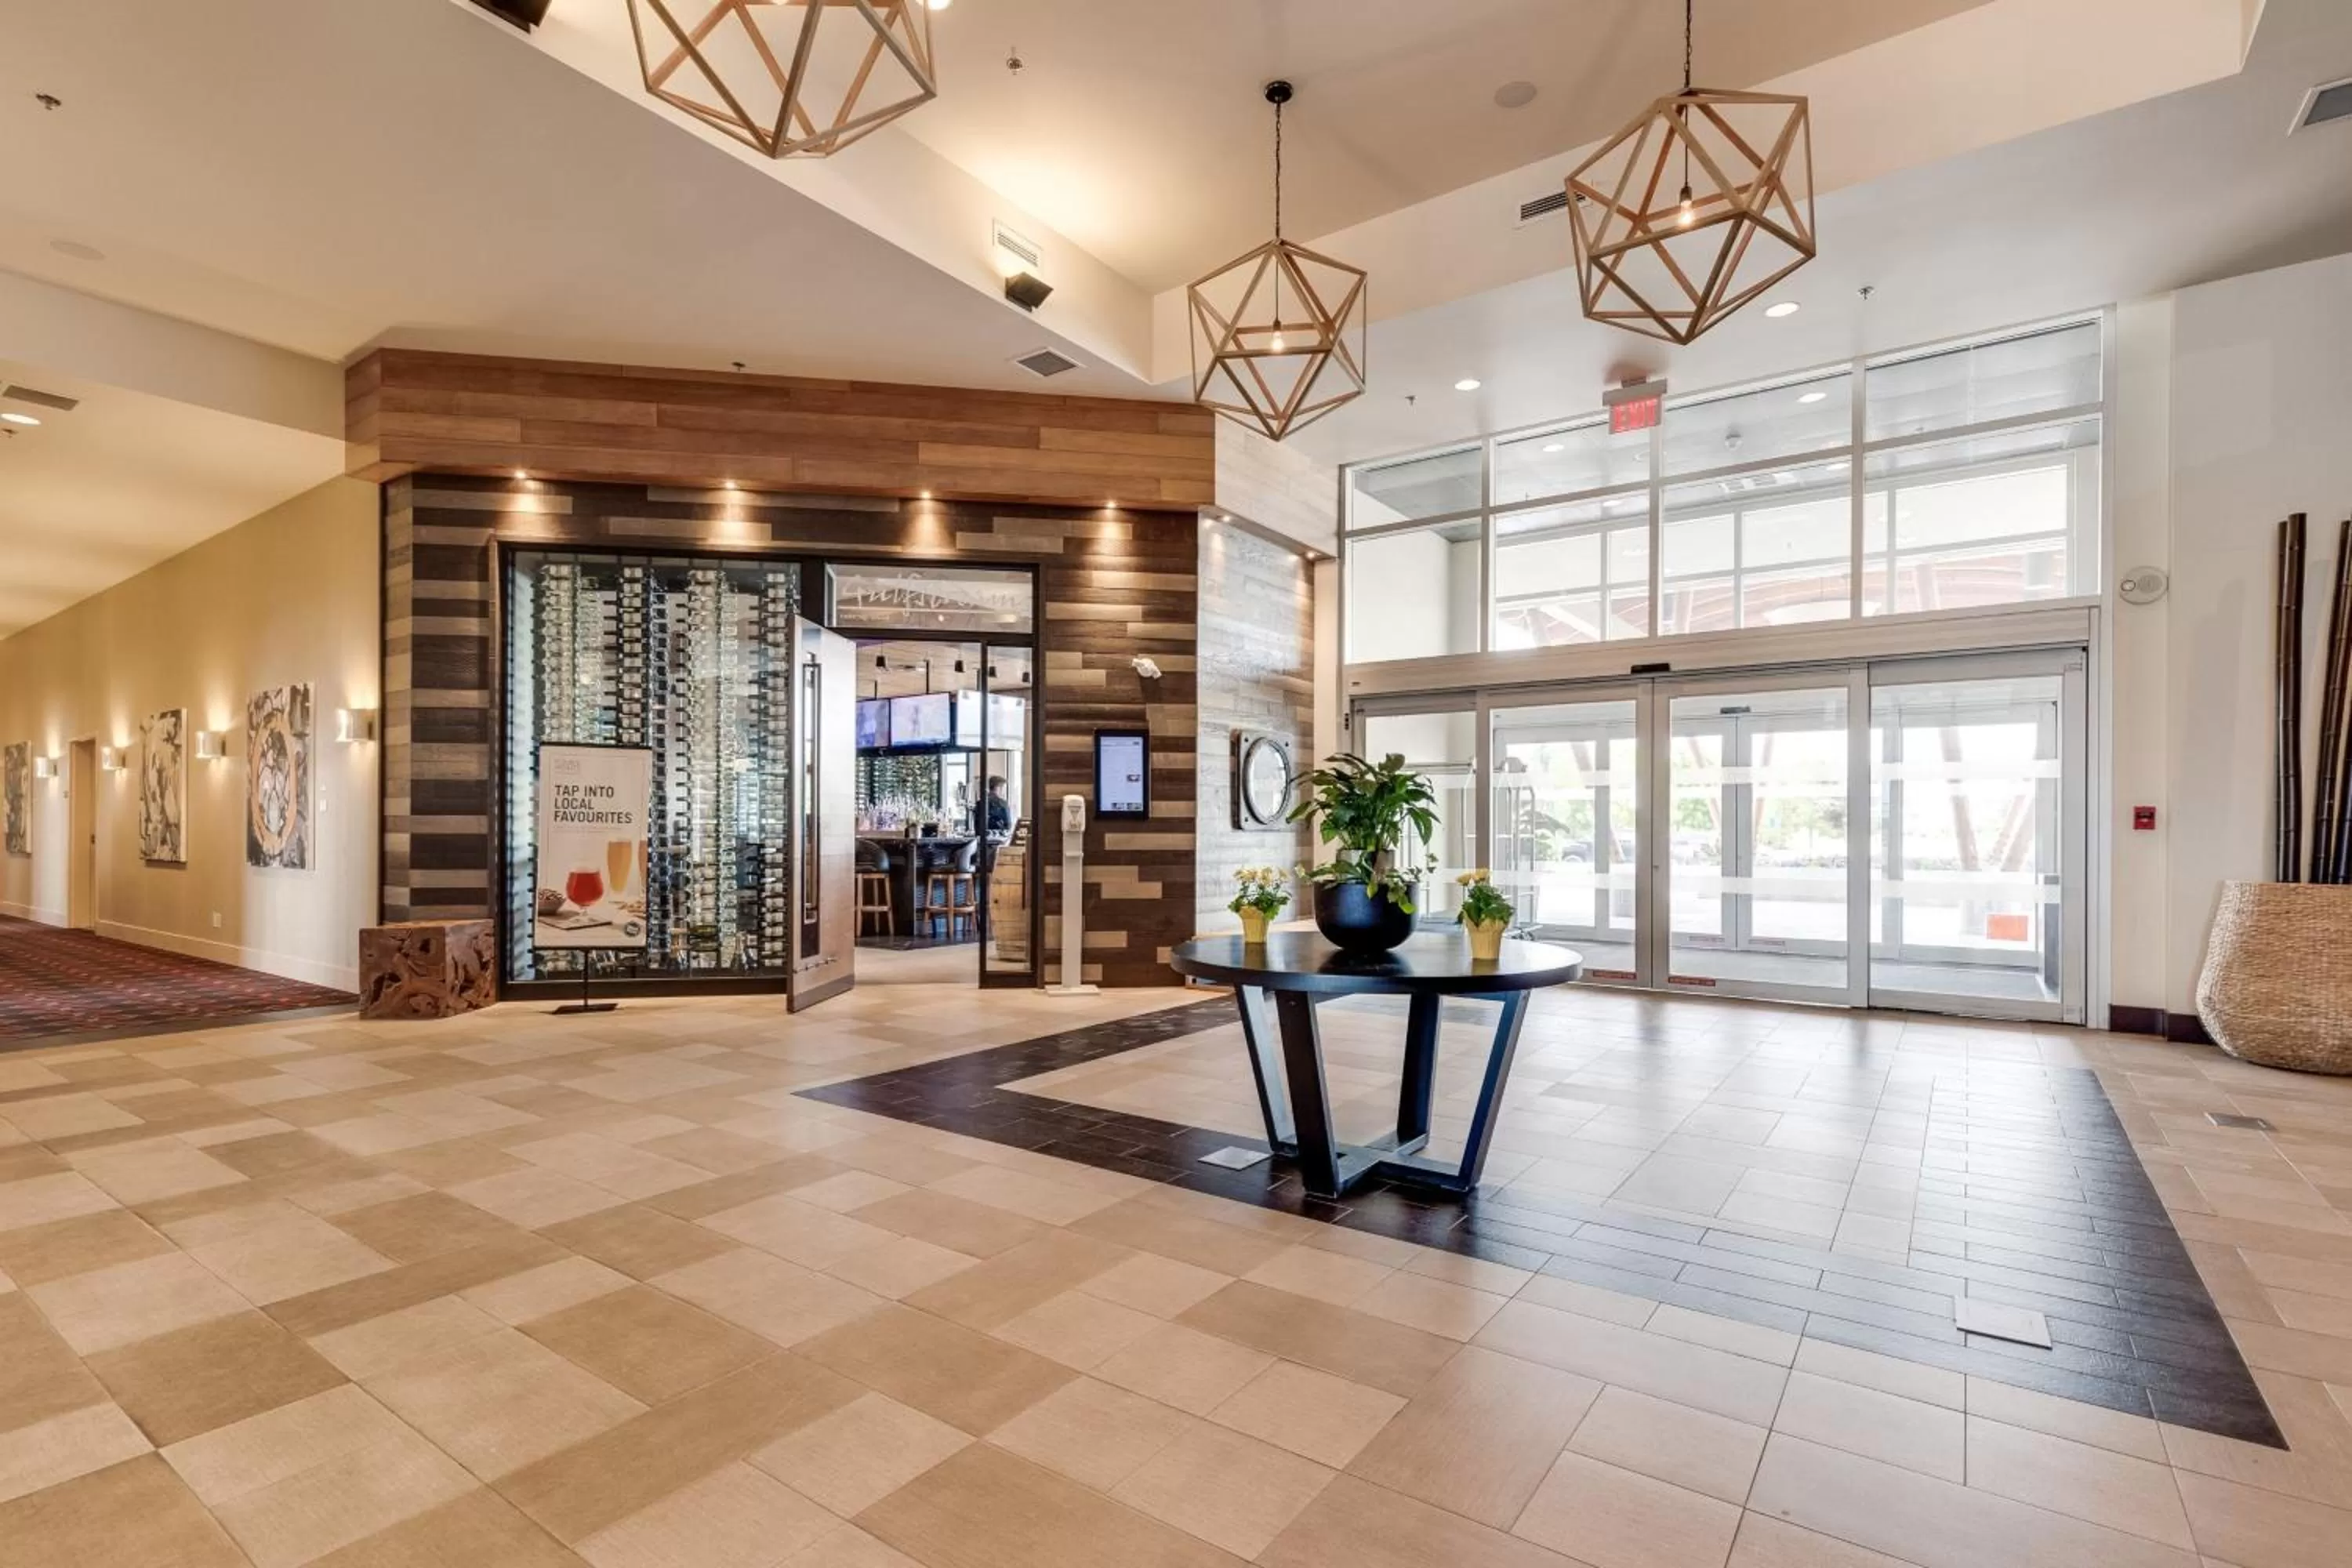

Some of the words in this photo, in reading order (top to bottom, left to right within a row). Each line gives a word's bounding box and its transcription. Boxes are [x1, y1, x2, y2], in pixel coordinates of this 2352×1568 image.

[554, 785, 579, 797] TAP
[584, 786, 615, 798] INTO
[554, 797, 594, 810] LOCAL
[554, 811, 633, 824] FAVOURITES
